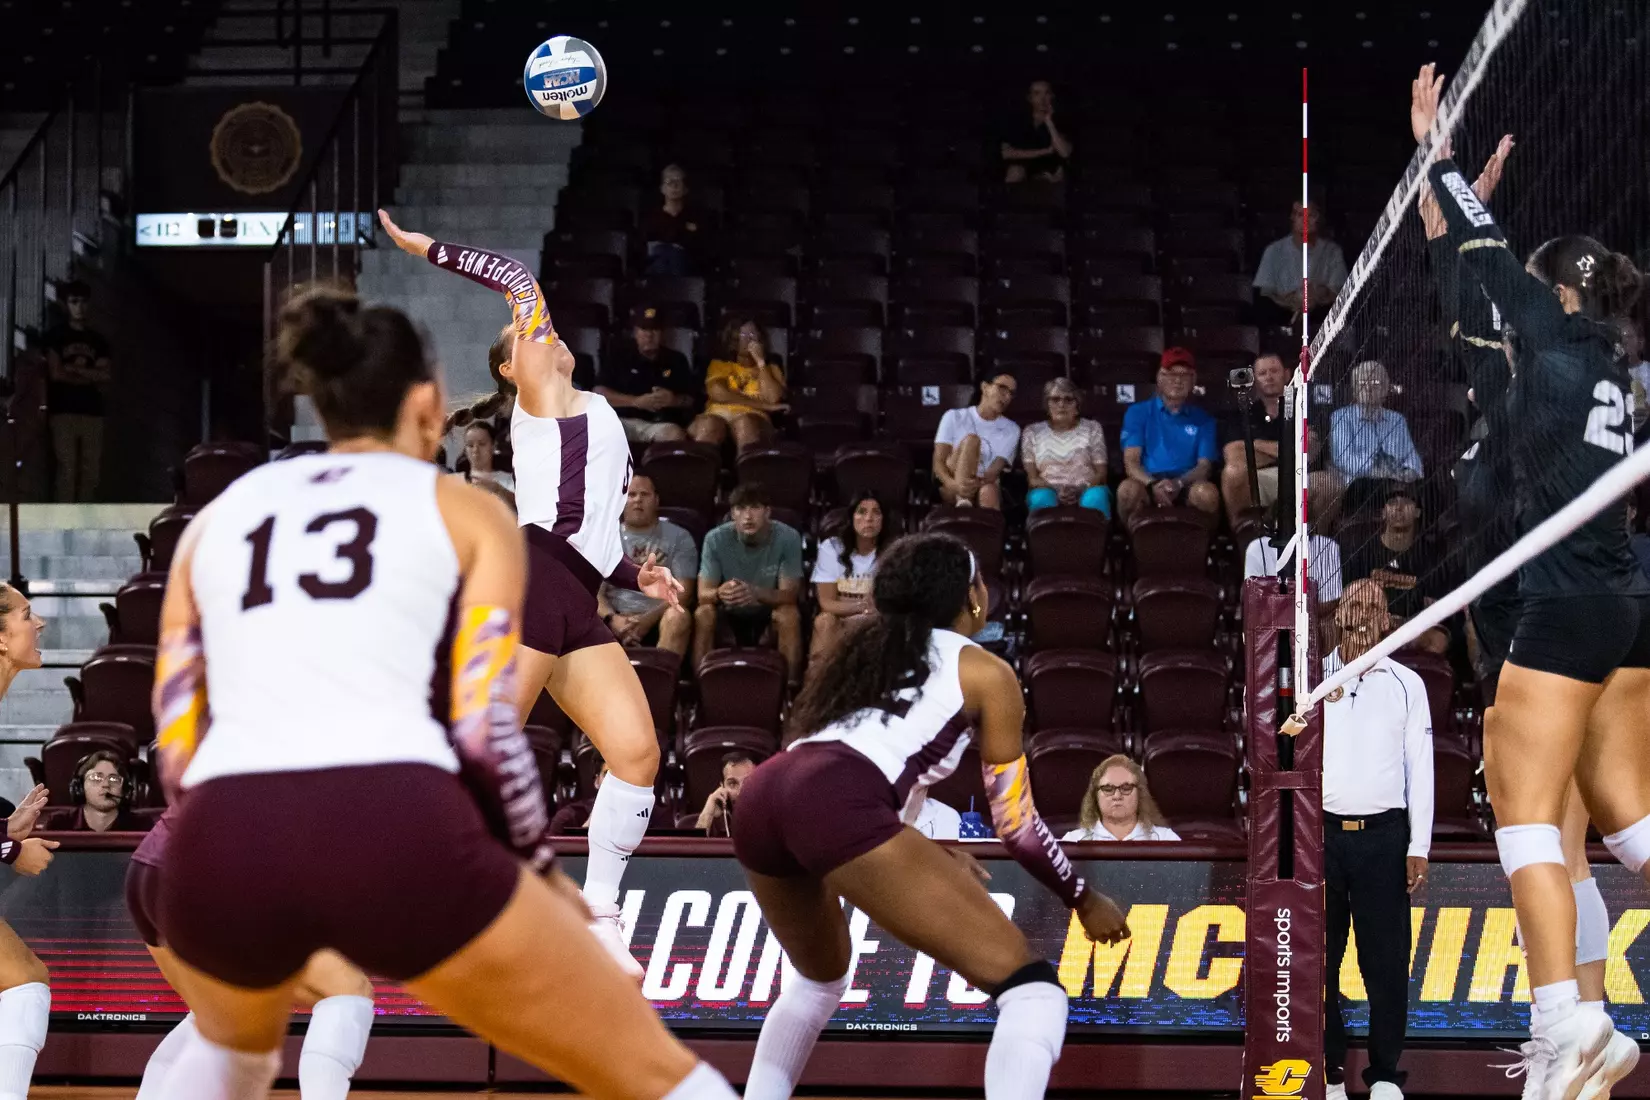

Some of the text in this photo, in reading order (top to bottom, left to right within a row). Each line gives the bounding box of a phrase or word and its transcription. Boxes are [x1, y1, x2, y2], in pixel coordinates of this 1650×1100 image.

[543, 69, 580, 88] NCAA
[543, 85, 588, 101] molten
[456, 250, 539, 304] CHIPPEWAS
[241, 504, 378, 612] 13
[1273, 907, 1292, 1043] sports imports
[77, 1013, 147, 1021] DAKTRONICS
[846, 1023, 918, 1031] DAKTRONICS
